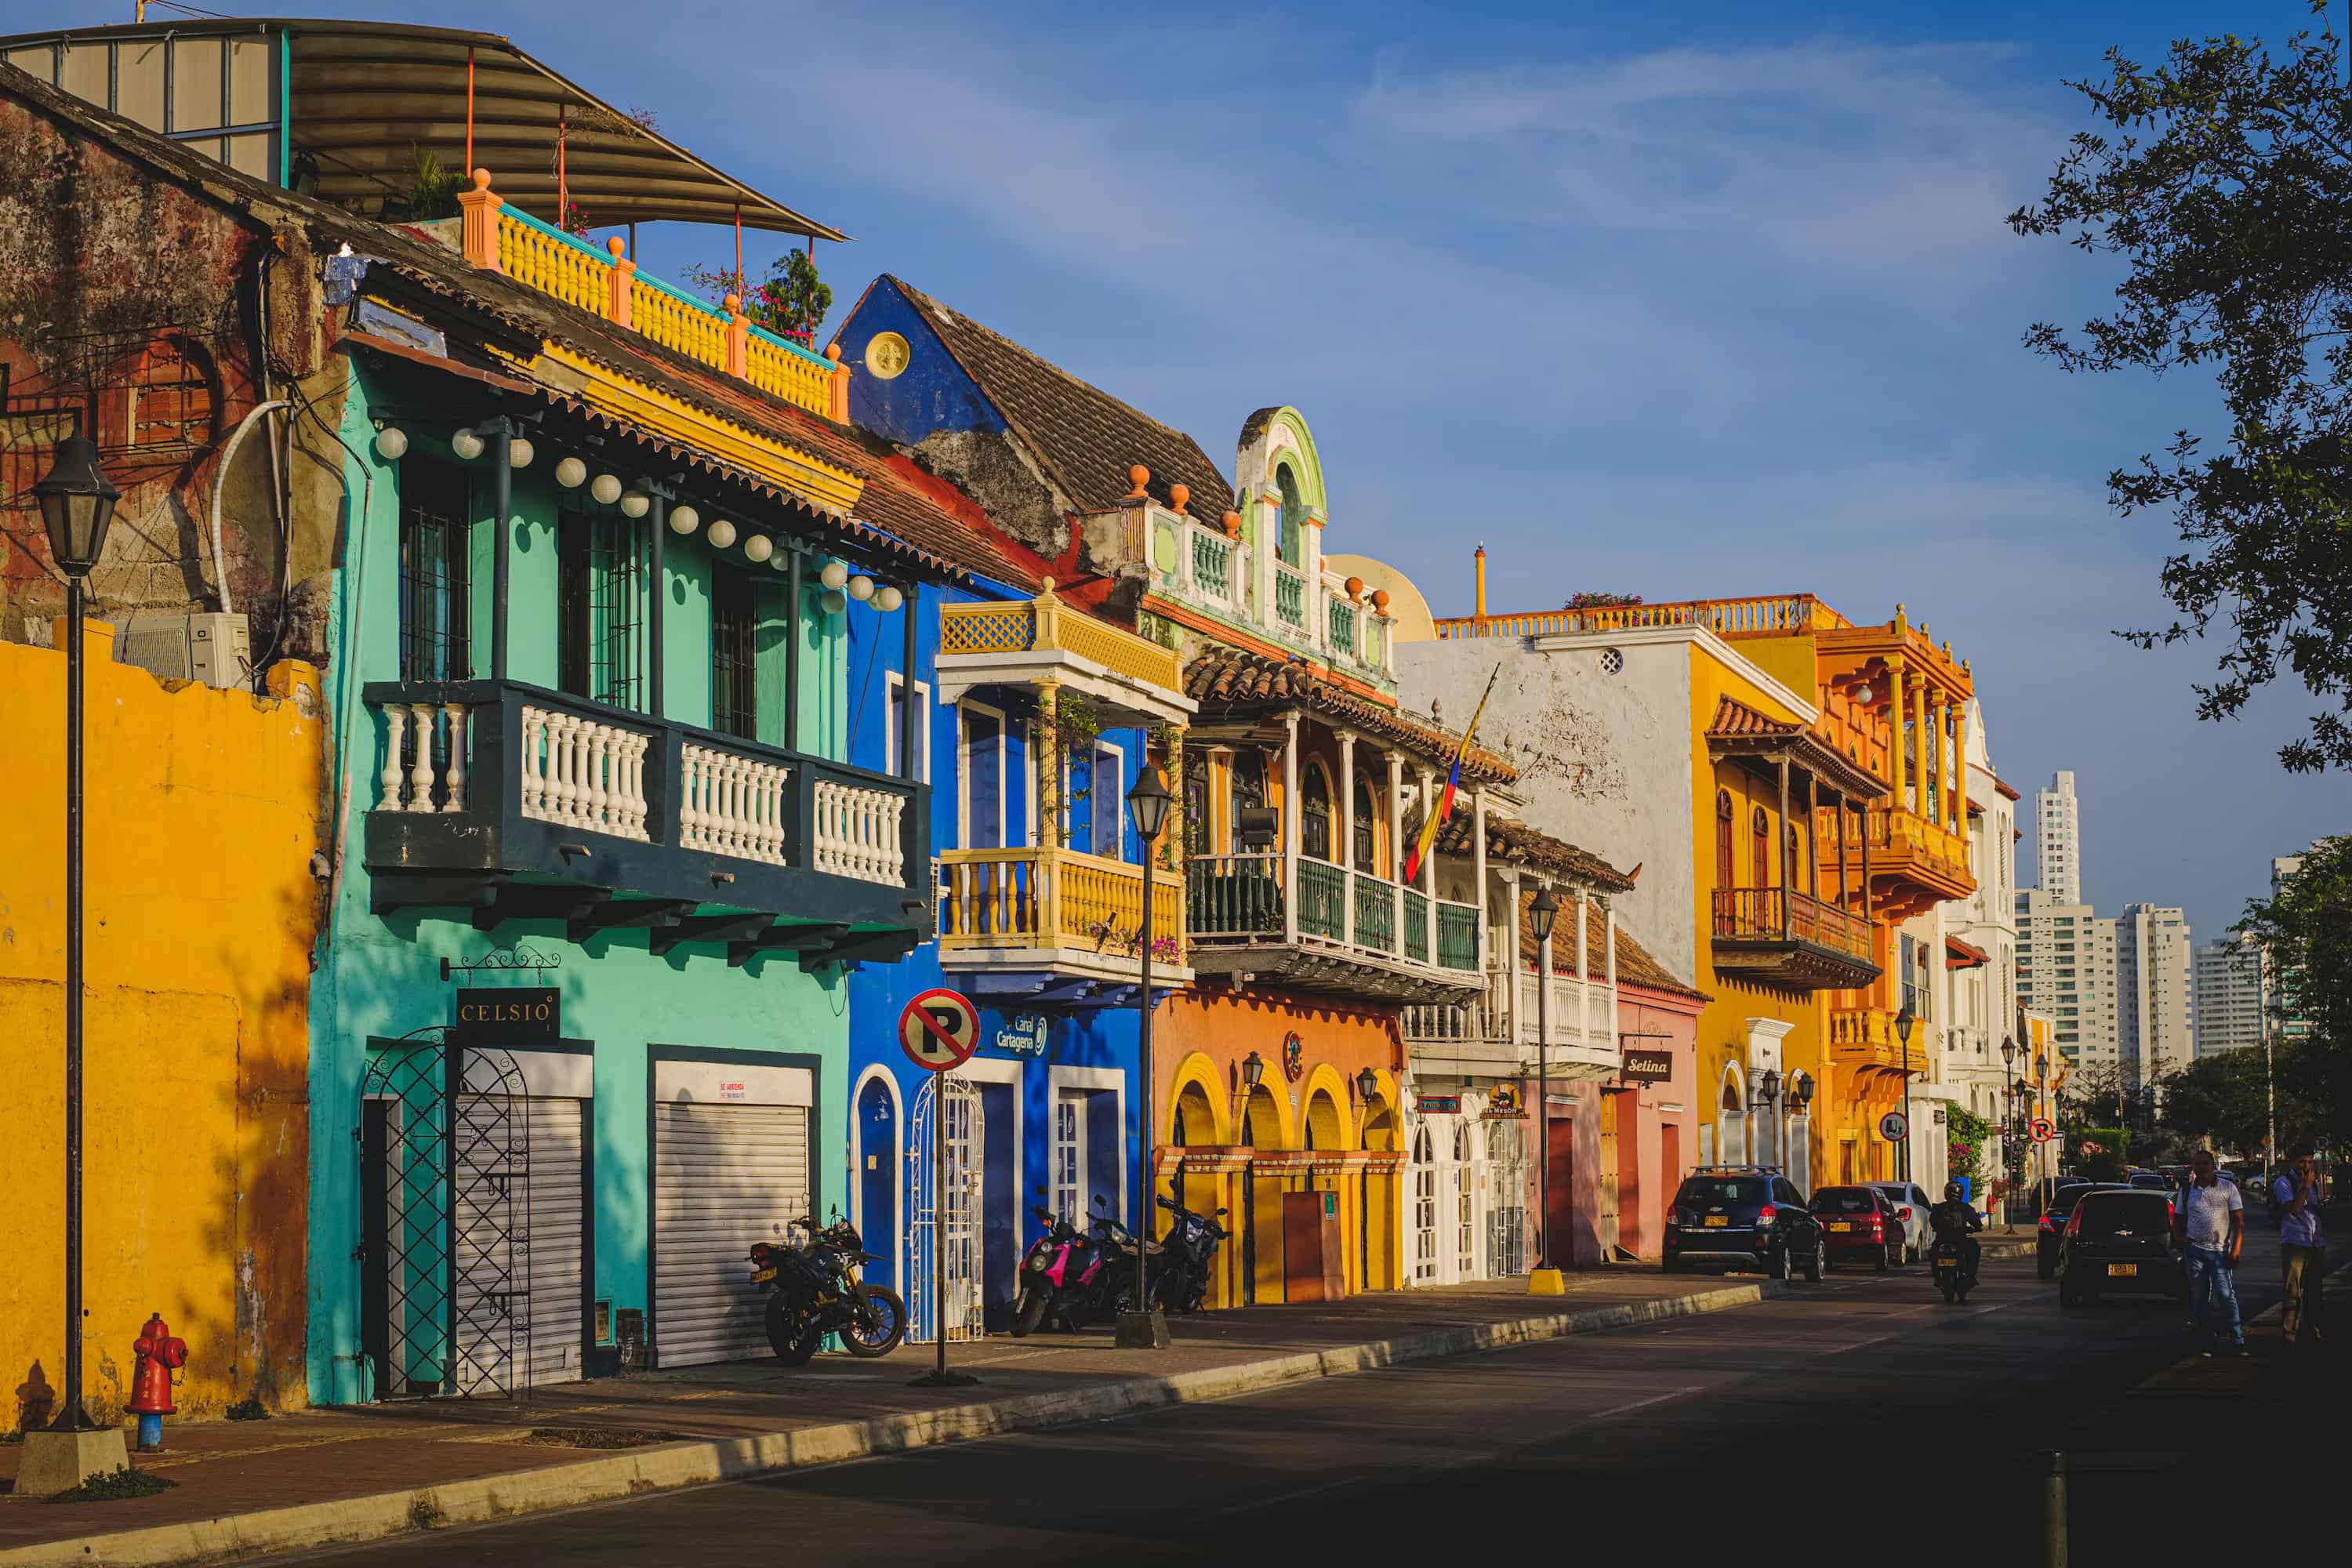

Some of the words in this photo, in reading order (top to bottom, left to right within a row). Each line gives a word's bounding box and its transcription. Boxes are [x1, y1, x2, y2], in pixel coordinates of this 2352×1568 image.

[1015, 1016, 1033, 1033] Canal
[996, 1030, 1033, 1052] Cartagena
[1628, 1058, 1668, 1073] Selina
